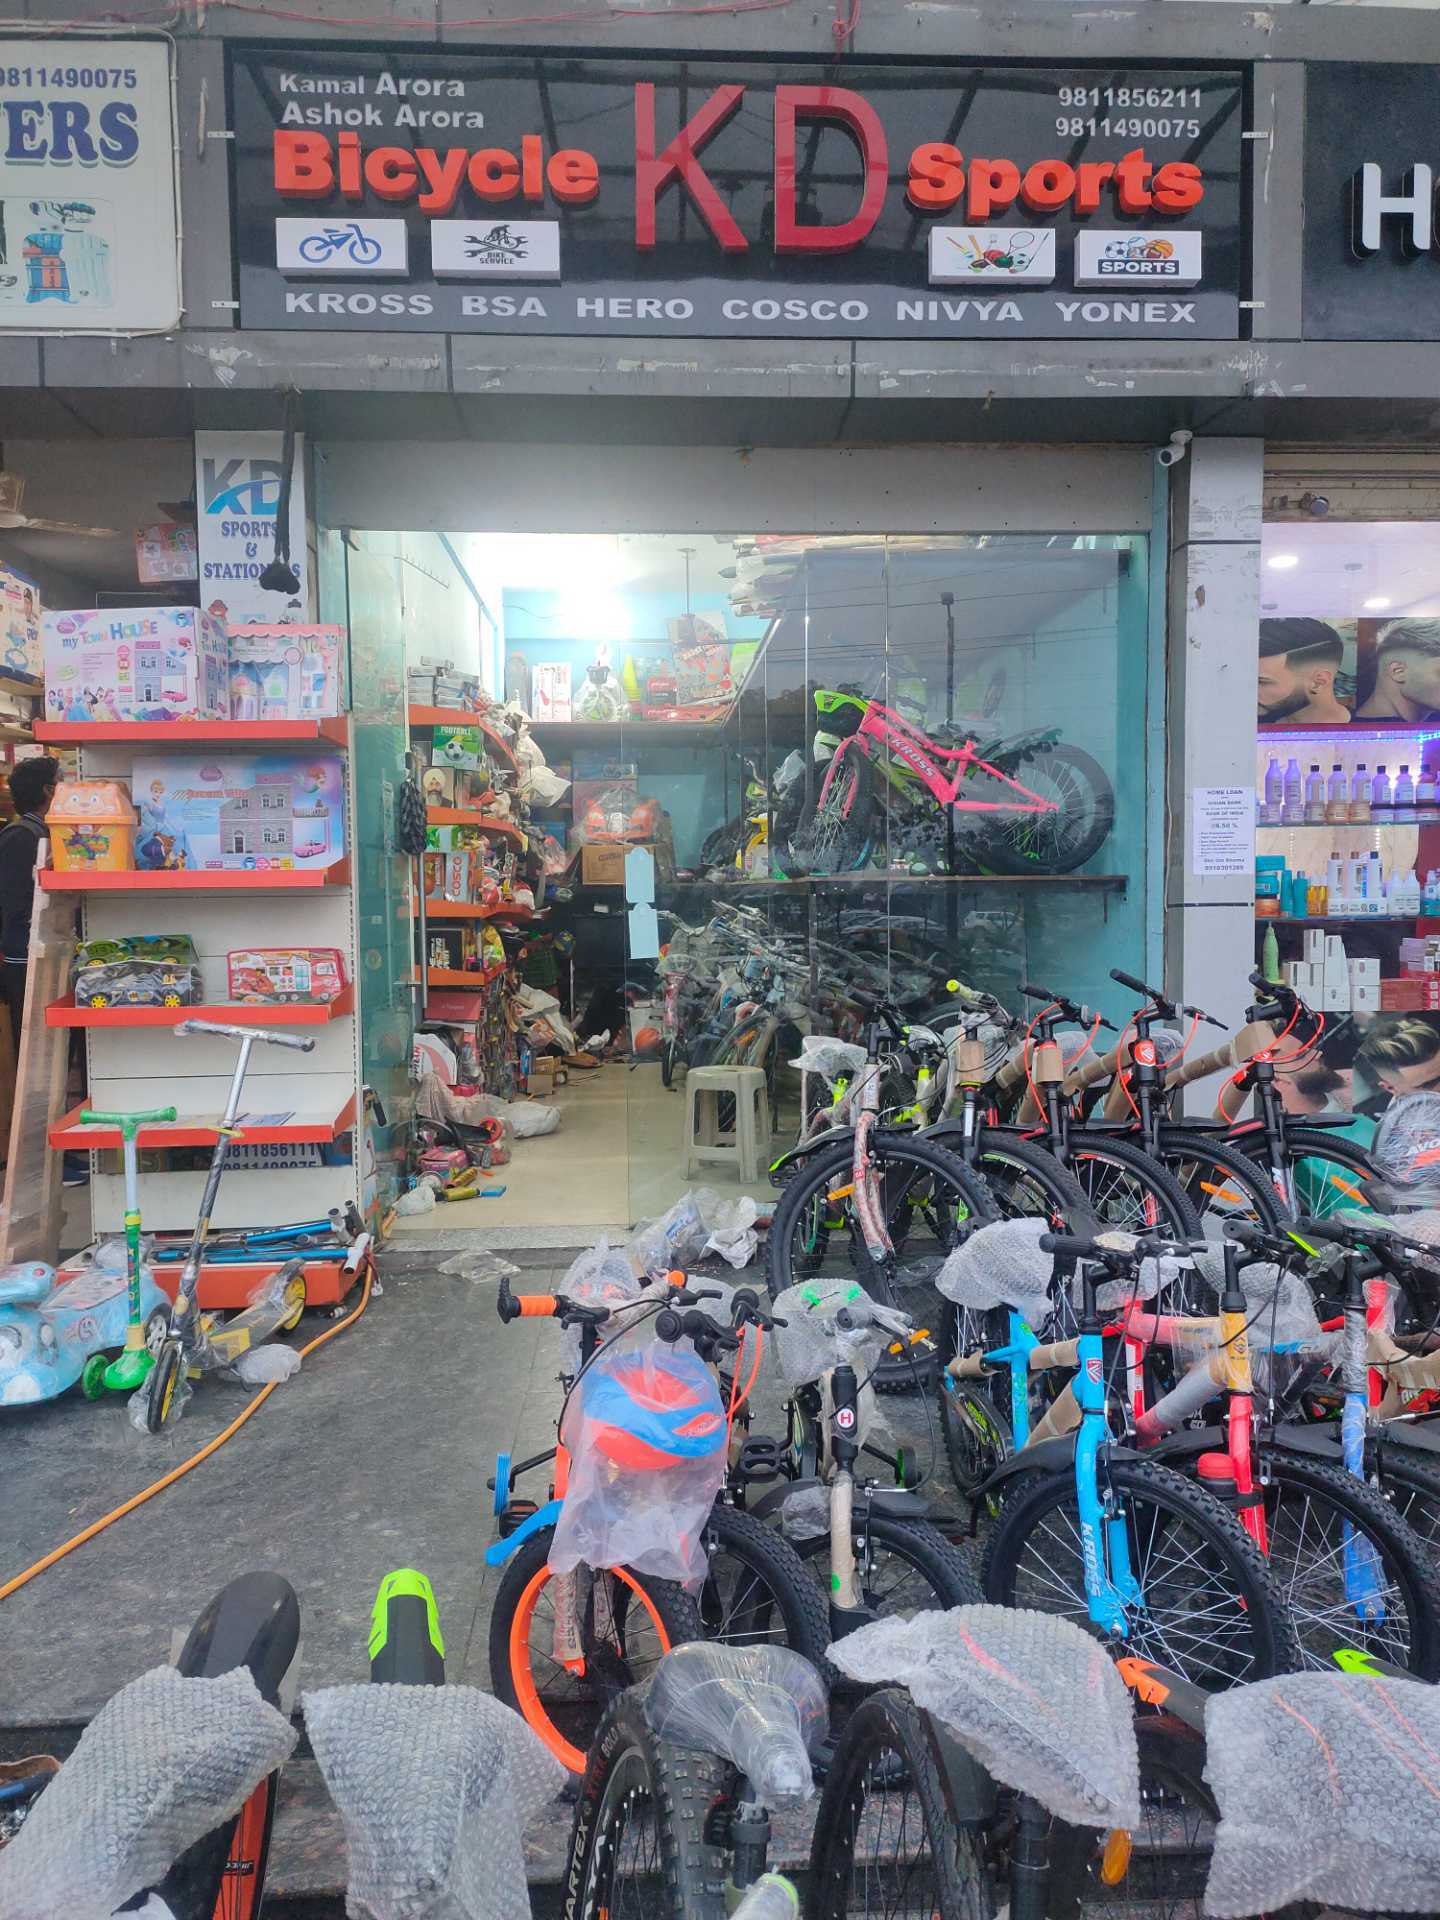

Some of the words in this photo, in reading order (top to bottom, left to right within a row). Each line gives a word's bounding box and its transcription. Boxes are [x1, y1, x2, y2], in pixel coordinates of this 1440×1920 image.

[280, 73, 365, 94] Kamal
[375, 72, 466, 97] Arora
[1058, 87, 1201, 108] 9811856211
[281, 101, 384, 126] Ashok
[394, 103, 485, 129] Arora
[1055, 117, 1200, 138] 9811490075
[0, 101, 139, 161] ERS
[274, 131, 599, 212] Bicycle
[907, 142, 1204, 222] Sports
[1362, 163, 1440, 249] H
[1101, 261, 1176, 273] SPORTS
[285, 293, 434, 315] KROSS
[461, 296, 547, 317] BSA
[576, 297, 694, 319] HERO
[722, 299, 870, 320] COSCO
[896, 300, 1024, 320] NIVYA
[1055, 301, 1196, 323] YONEX
[246, 542, 257, 558] &
[453, 856, 463, 896] COSCO
[564, 1815, 588, 1920] ARTEX
